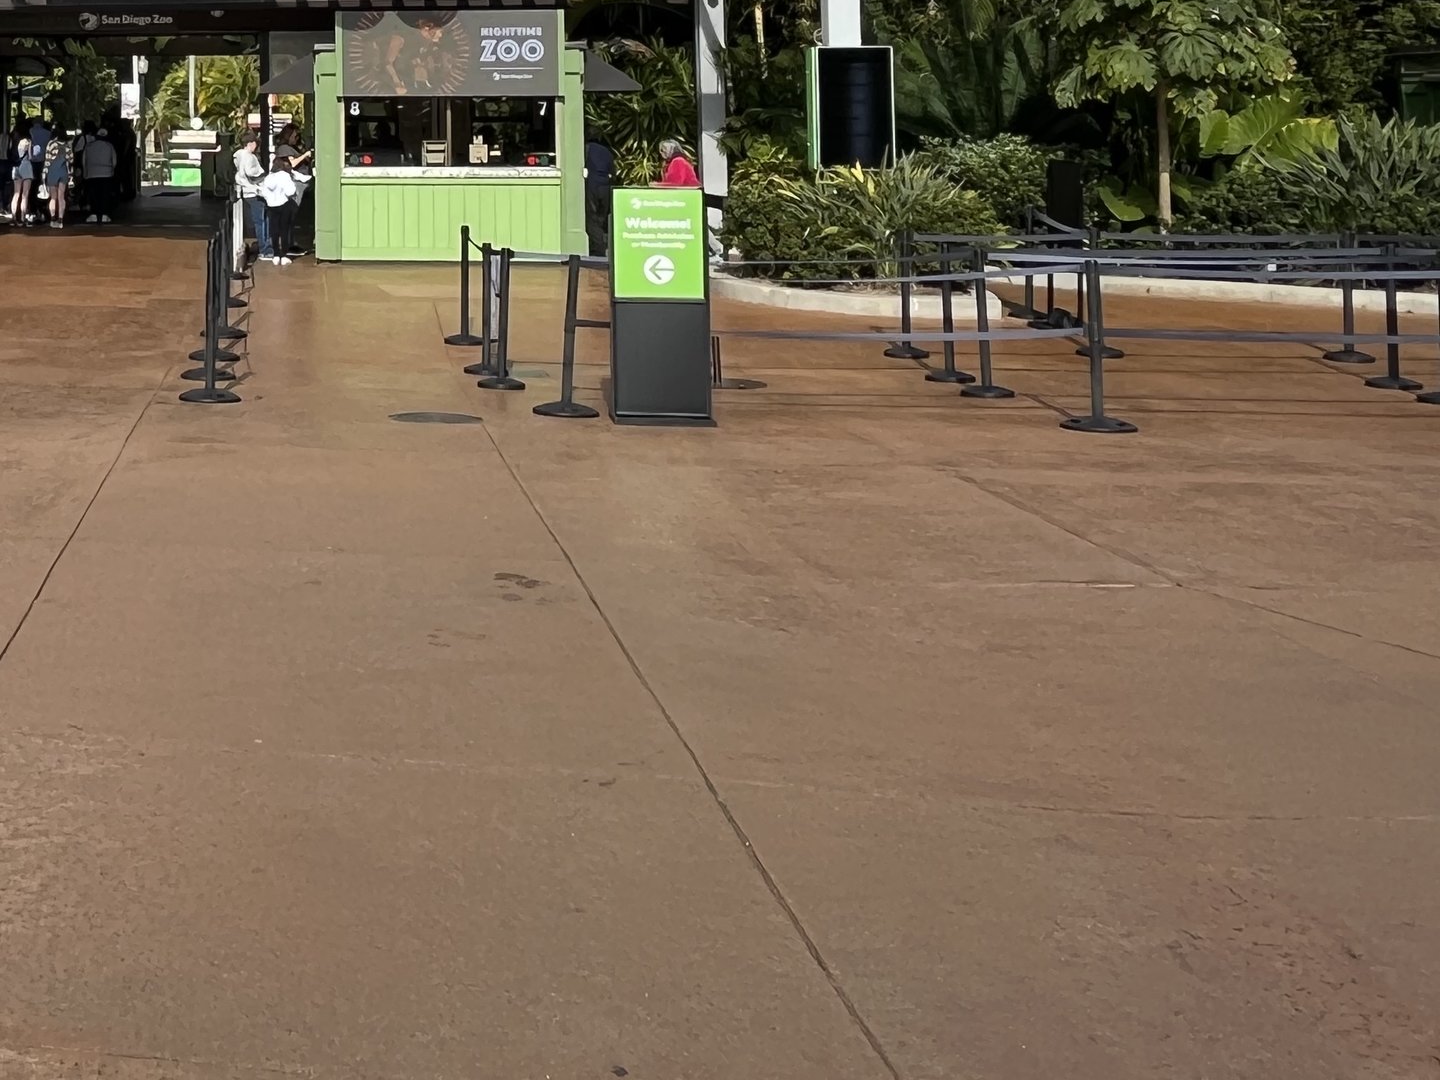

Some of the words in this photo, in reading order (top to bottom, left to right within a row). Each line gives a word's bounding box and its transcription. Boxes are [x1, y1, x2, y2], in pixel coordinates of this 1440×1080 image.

[101, 15, 120, 24] San
[122, 14, 152, 25] Diego
[152, 15, 173, 24] Zoo
[480, 27, 542, 36] NIGHTTIME
[479, 39, 545, 62] ZOO
[349, 101, 360, 116] 8
[537, 101, 547, 116] 7
[625, 217, 691, 230] Welcome!
